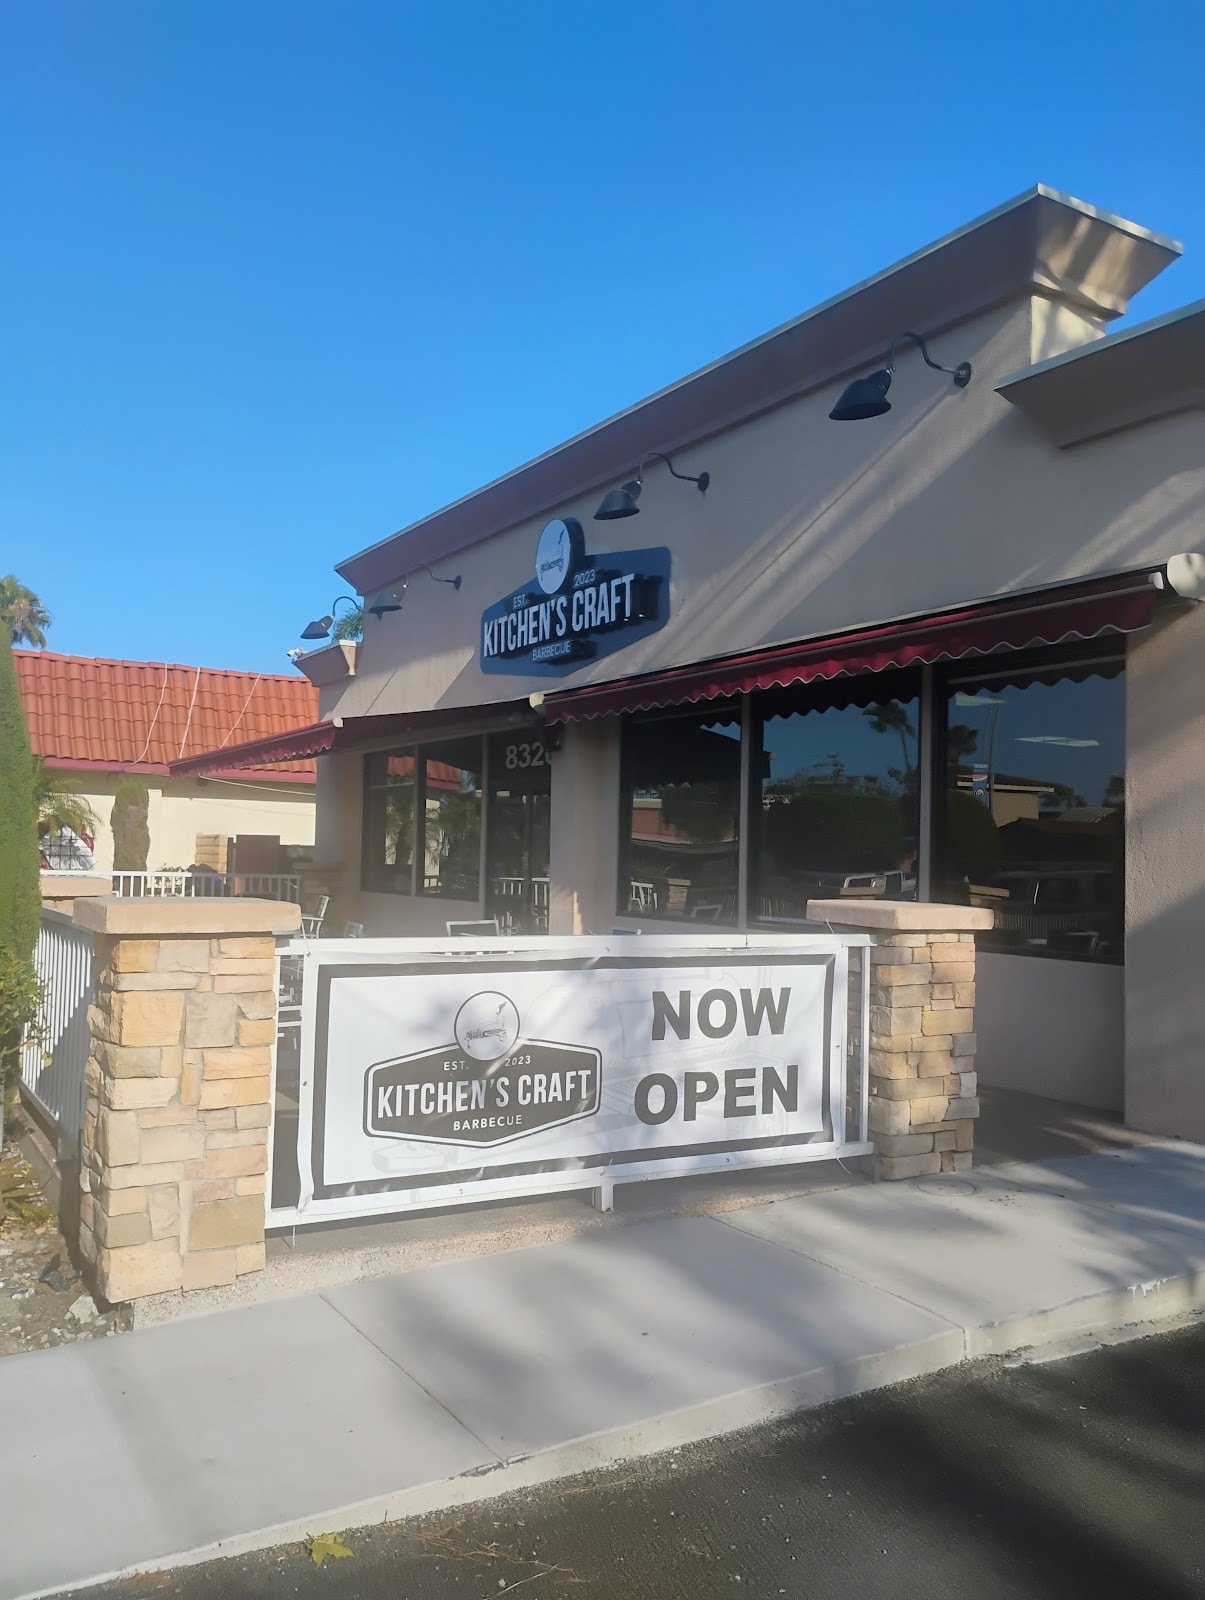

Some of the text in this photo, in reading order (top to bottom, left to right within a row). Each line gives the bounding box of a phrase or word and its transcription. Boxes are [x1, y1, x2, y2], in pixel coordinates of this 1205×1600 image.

[513, 569, 596, 609] EST. 2023
[483, 573, 635, 658] KITCHEN'S CRAFT
[532, 639, 571, 662] BARBECUE
[651, 986, 792, 1041] NOW
[443, 1055, 532, 1071] EST. 2023
[377, 1069, 592, 1119] KITCHEN'S CRAFT
[634, 1064, 799, 1126] OPEN
[453, 1114, 523, 1131] BARBECUE
